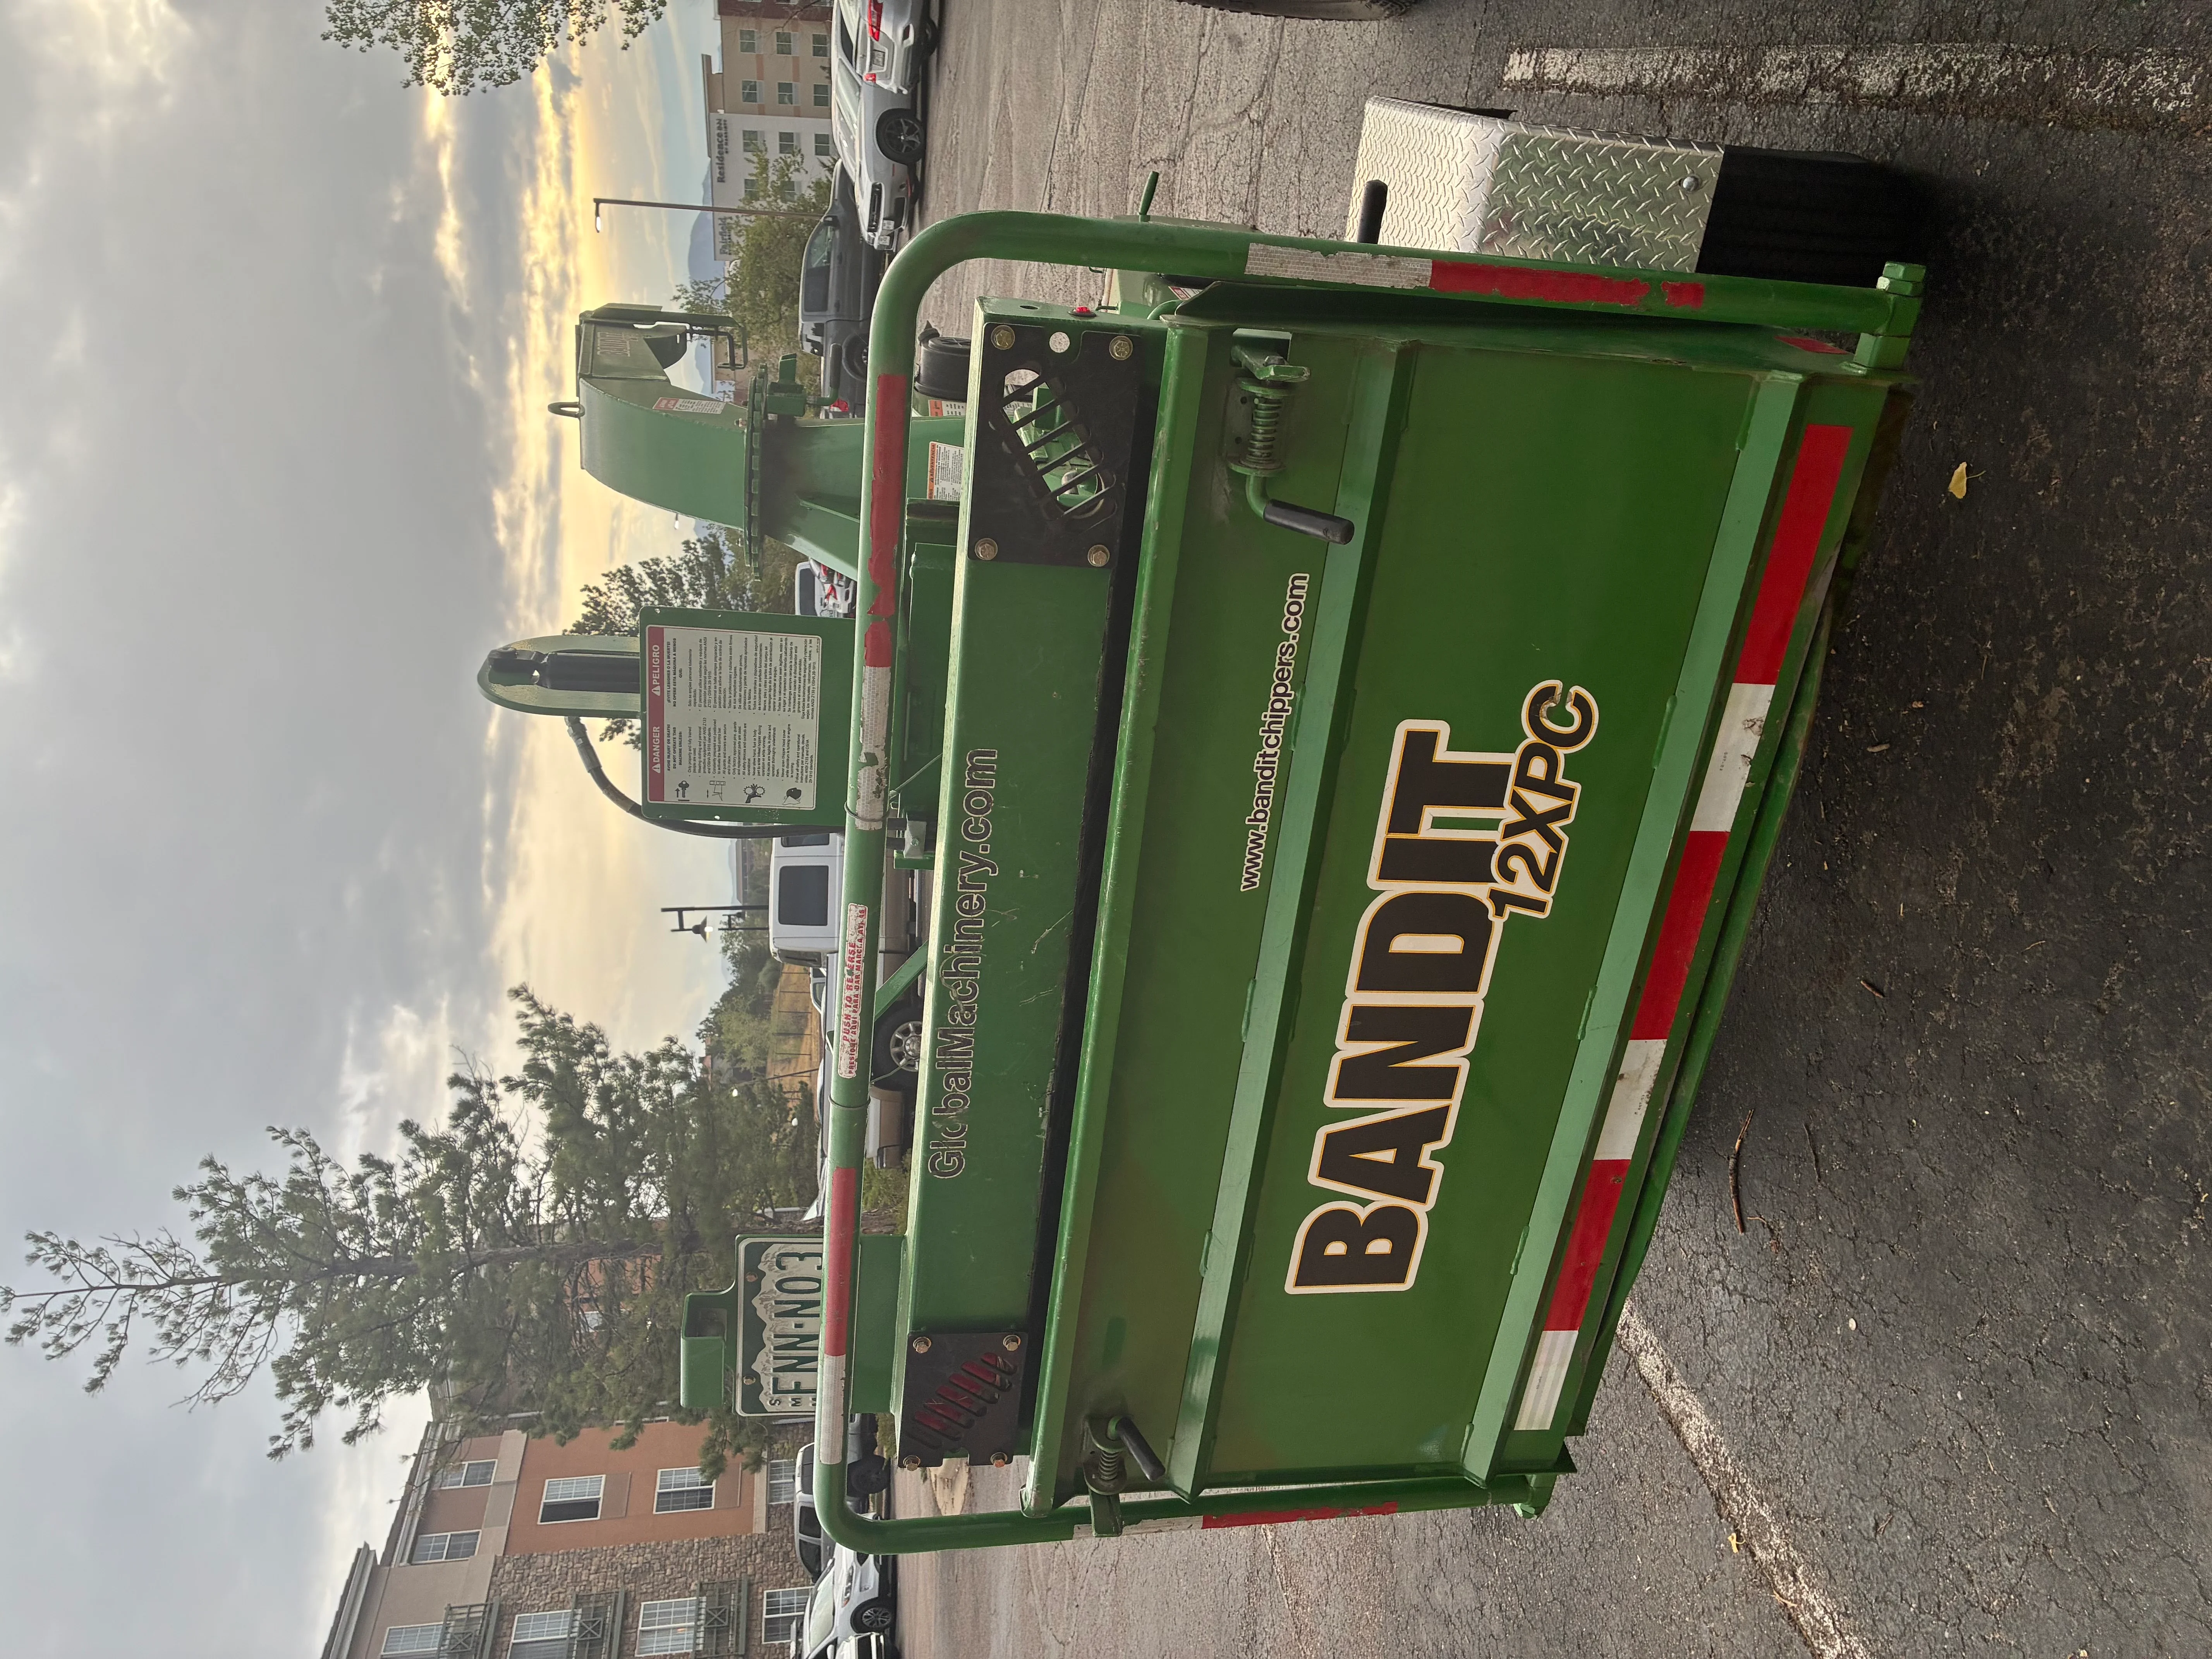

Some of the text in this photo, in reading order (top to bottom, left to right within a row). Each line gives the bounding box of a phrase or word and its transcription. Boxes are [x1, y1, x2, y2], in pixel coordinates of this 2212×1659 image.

[716, 132, 725, 183] Residence
[1241, 574, 1309, 891] www.banditchippers.com
[1488, 684, 1596, 918] 12XPC
[843, 943, 856, 1042] PUSH TO REERSE
[928, 749, 998, 1179] GlobalMachinery.com
[1289, 724, 1513, 1291] BANDIT
